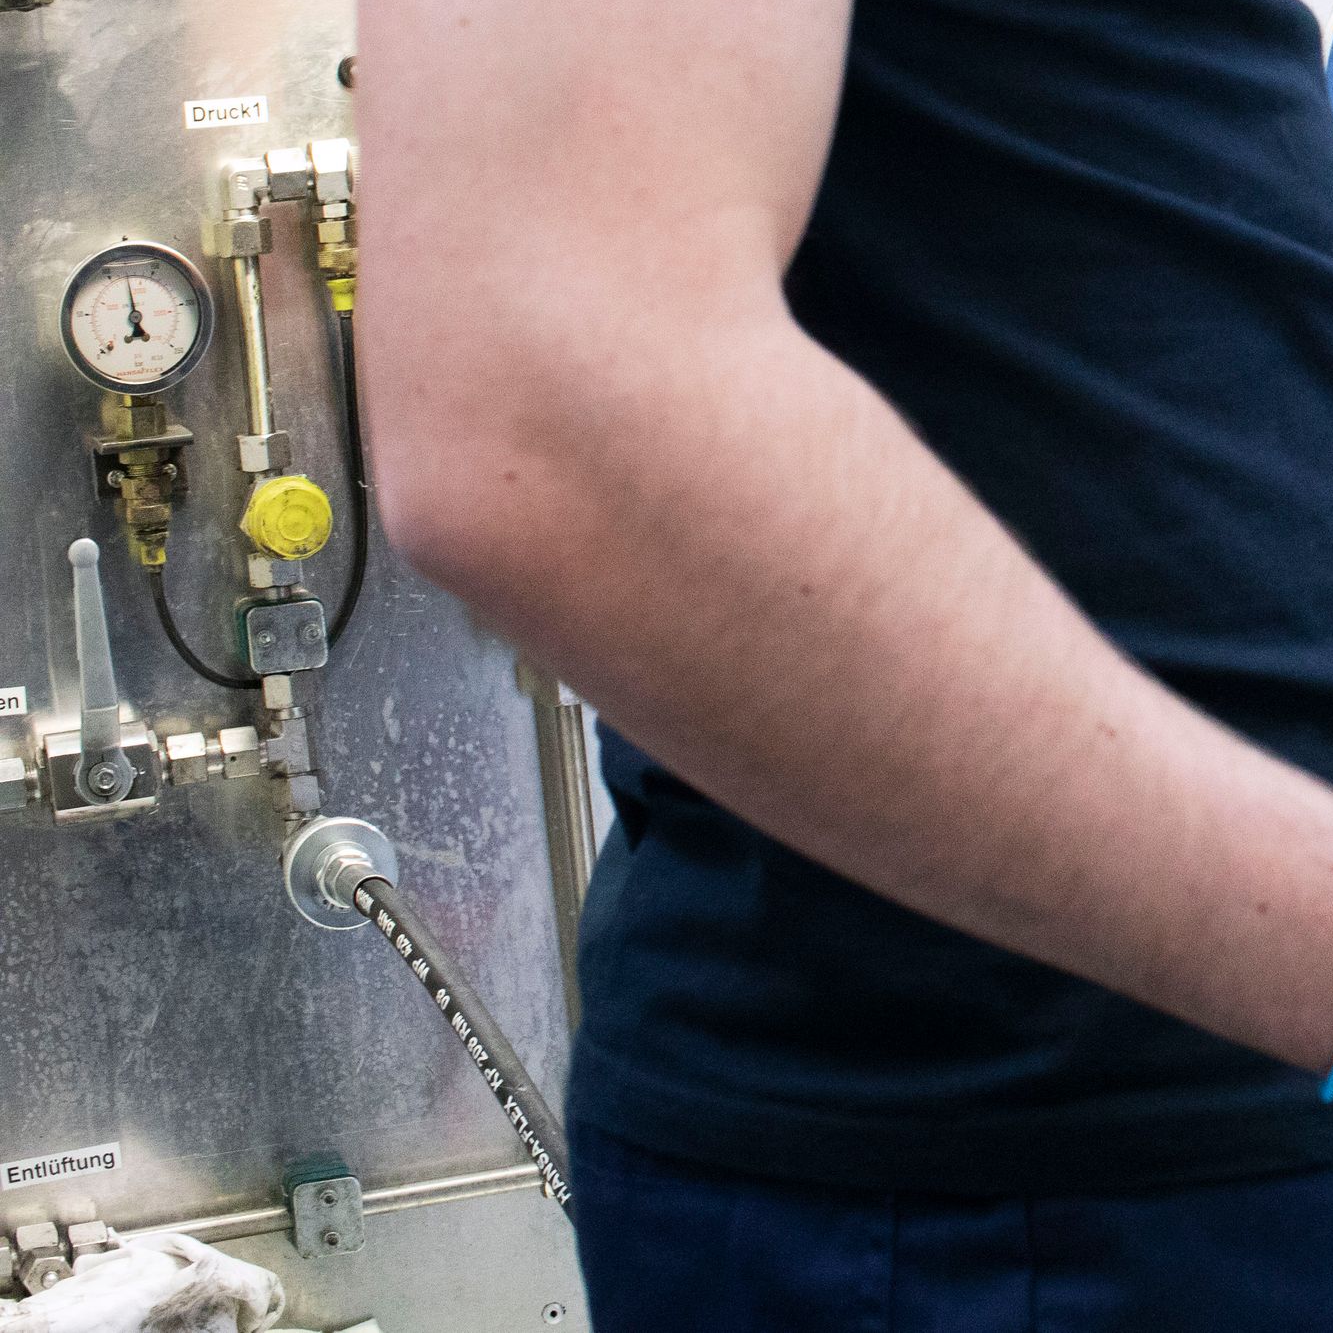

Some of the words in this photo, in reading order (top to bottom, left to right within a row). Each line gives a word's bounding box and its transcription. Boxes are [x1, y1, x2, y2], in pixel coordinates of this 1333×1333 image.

[192, 102, 260, 122] Druck1
[412, 957, 430, 983] WP
[435, 988, 451, 1011] 08
[451, 1011, 471, 1042] RM
[467, 1036, 489, 1068] 208
[483, 1067, 503, 1092] KP
[503, 1095, 573, 1206] HANSA-FLEX
[7, 1151, 116, 1184] Entlüftung
